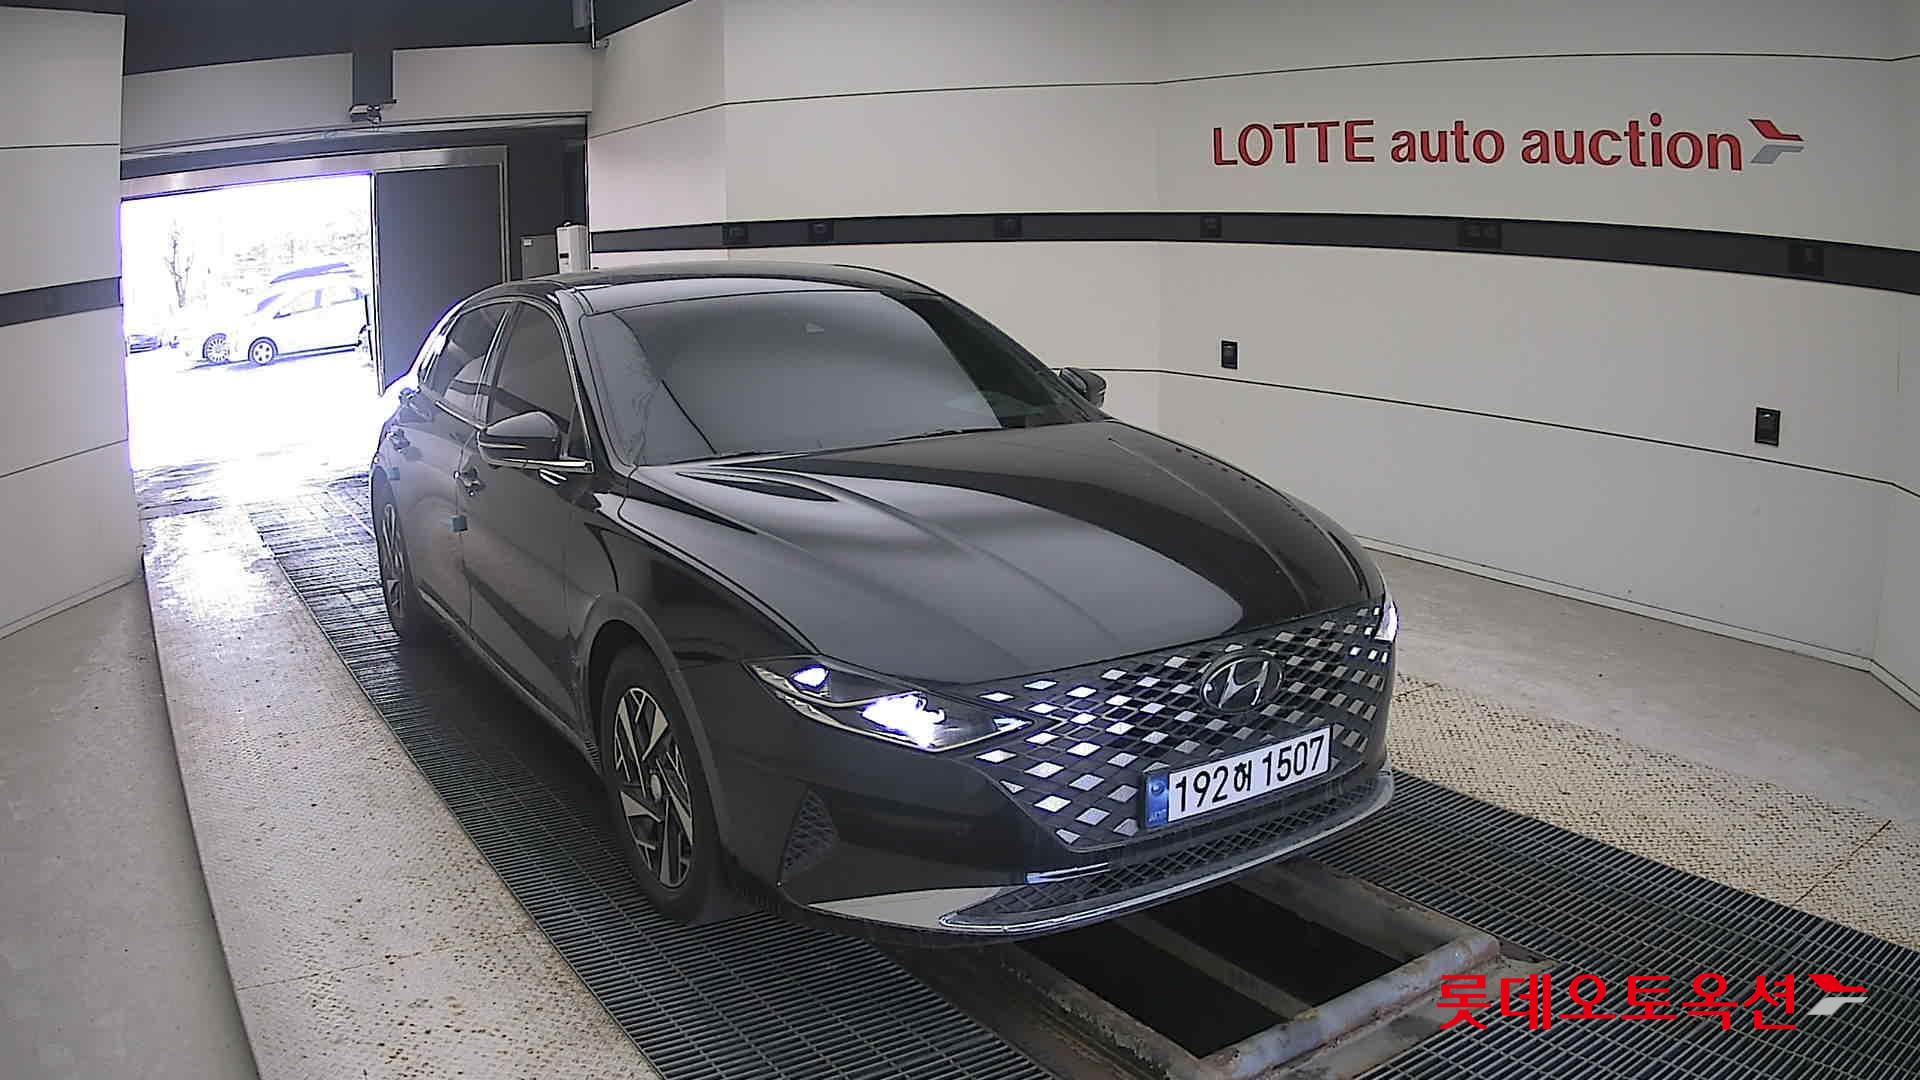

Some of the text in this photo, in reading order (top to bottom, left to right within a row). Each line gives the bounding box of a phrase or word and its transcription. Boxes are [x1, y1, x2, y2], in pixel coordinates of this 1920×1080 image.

[1212, 111, 1743, 171] LOTTE auto auction
[1175, 734, 1325, 813] 192허 1507
